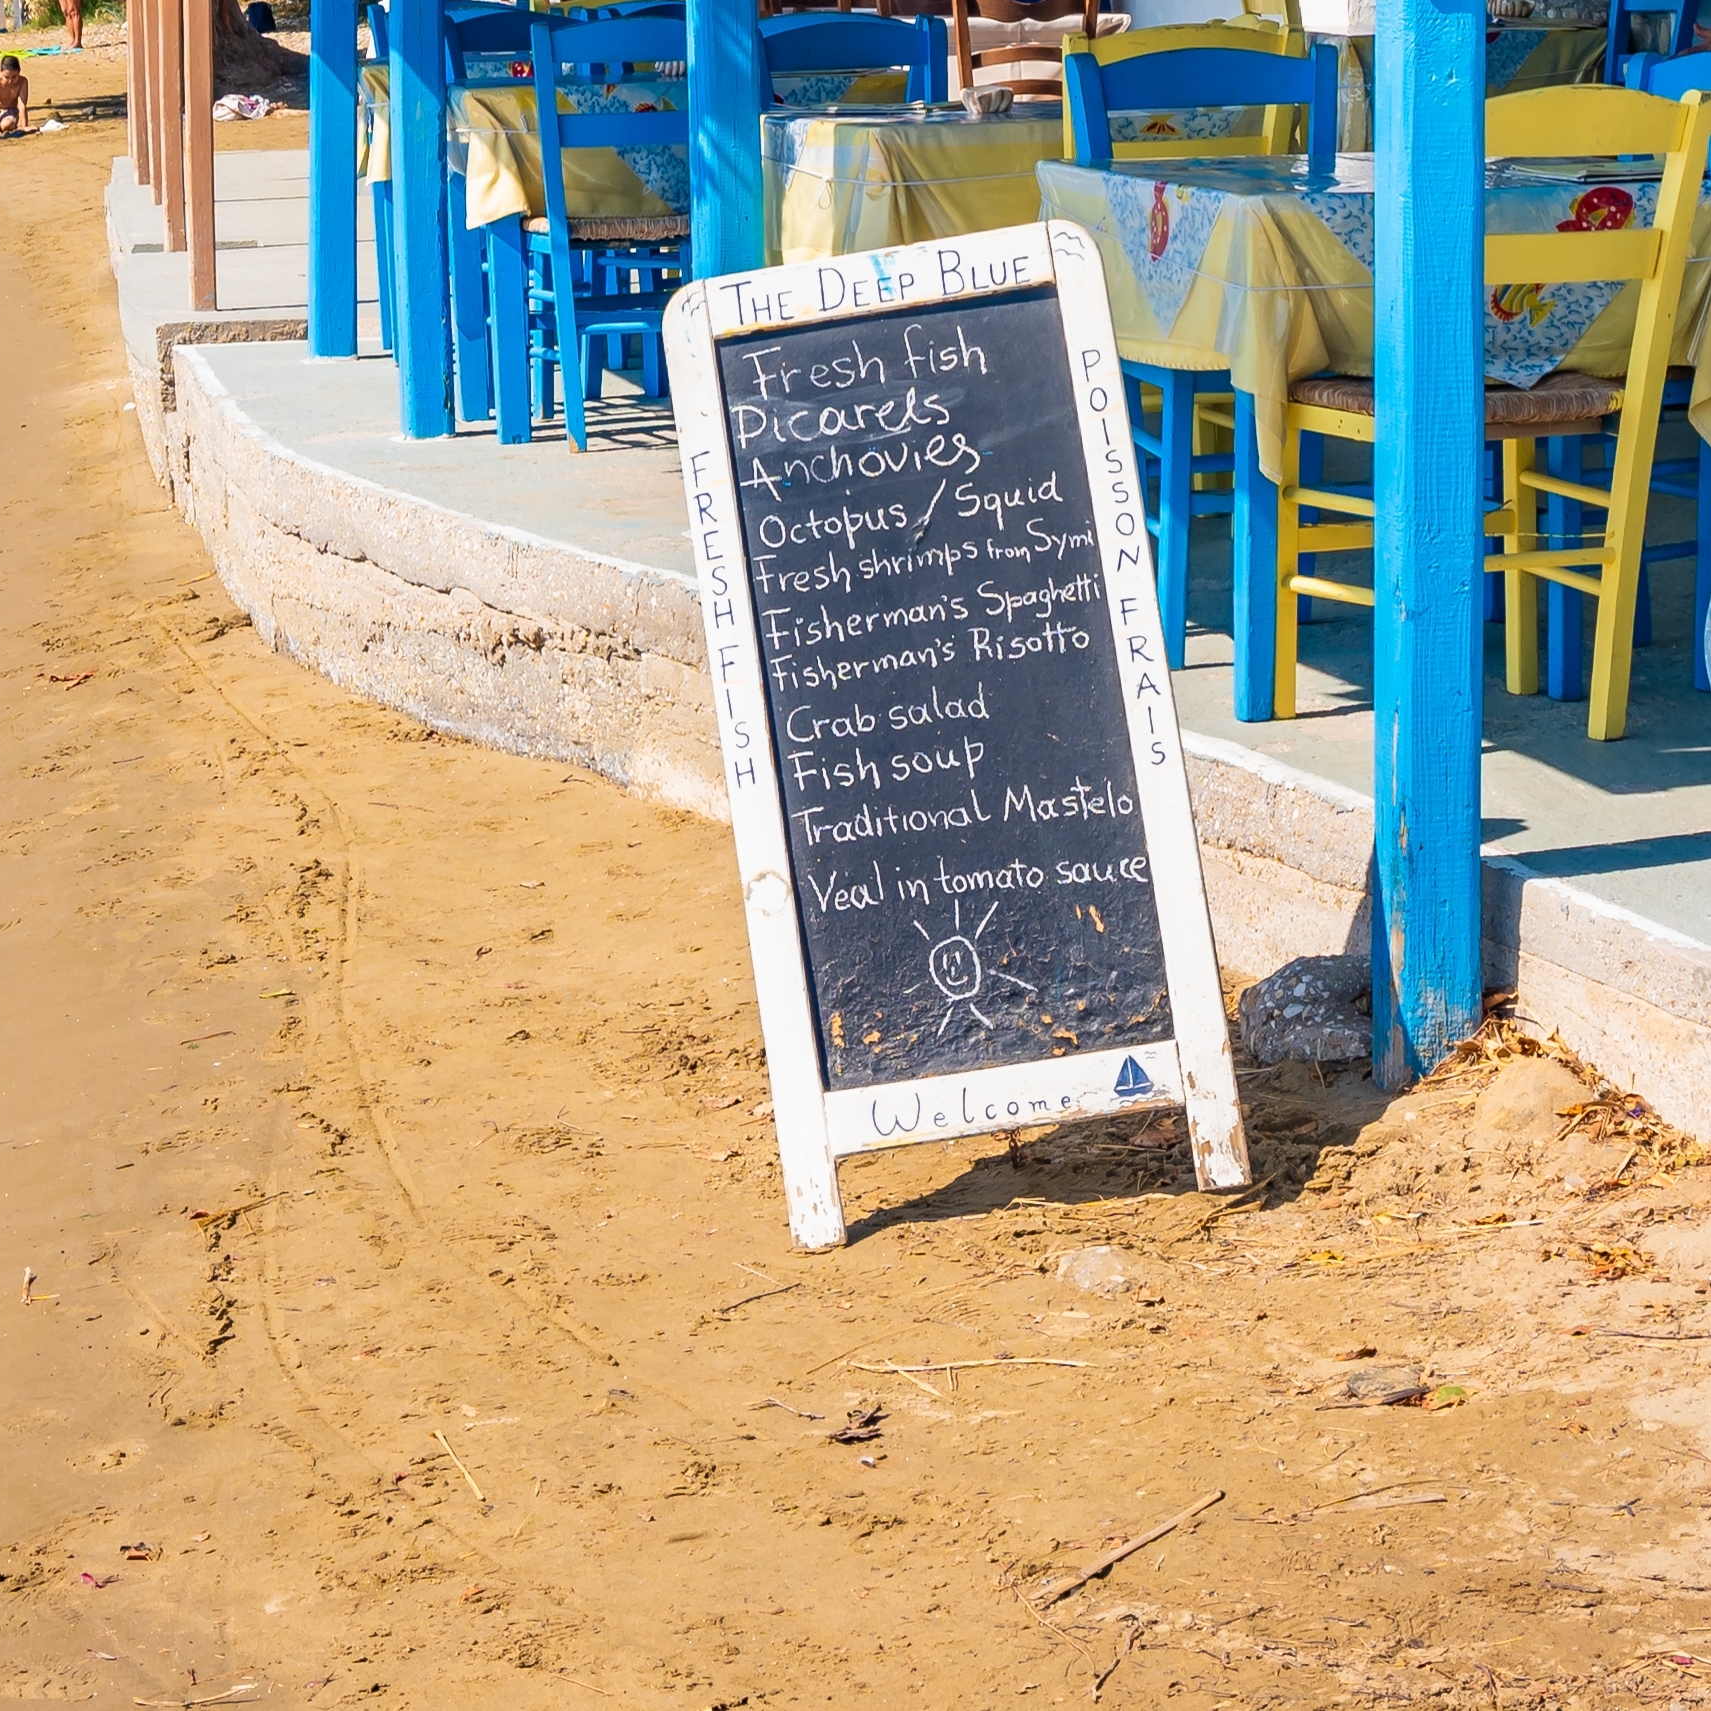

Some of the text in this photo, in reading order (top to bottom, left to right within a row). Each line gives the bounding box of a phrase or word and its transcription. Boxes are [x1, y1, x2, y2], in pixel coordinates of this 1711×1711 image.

[719, 249, 1032, 325] THE DEEP BLUE
[742, 345, 886, 400] Fresh
[759, 501, 908, 551] Octopus
[955, 471, 1063, 530] Squid
[754, 518, 1096, 594] Fresh shrimps from Symi
[1081, 349, 1167, 767] POISSON FRAIS
[690, 451, 757, 789] FRESH FISH
[762, 571, 1102, 651] Fisherman's Spaghetti
[769, 626, 1090, 691] Fisherman's Risotto
[786, 682, 991, 744] Crab salad
[787, 736, 985, 792] Fish soup
[790, 775, 1134, 847] Traditional Mastelo
[808, 853, 1151, 913] Veal in tomato sauce
[871, 1087, 1072, 1137] Welcome
